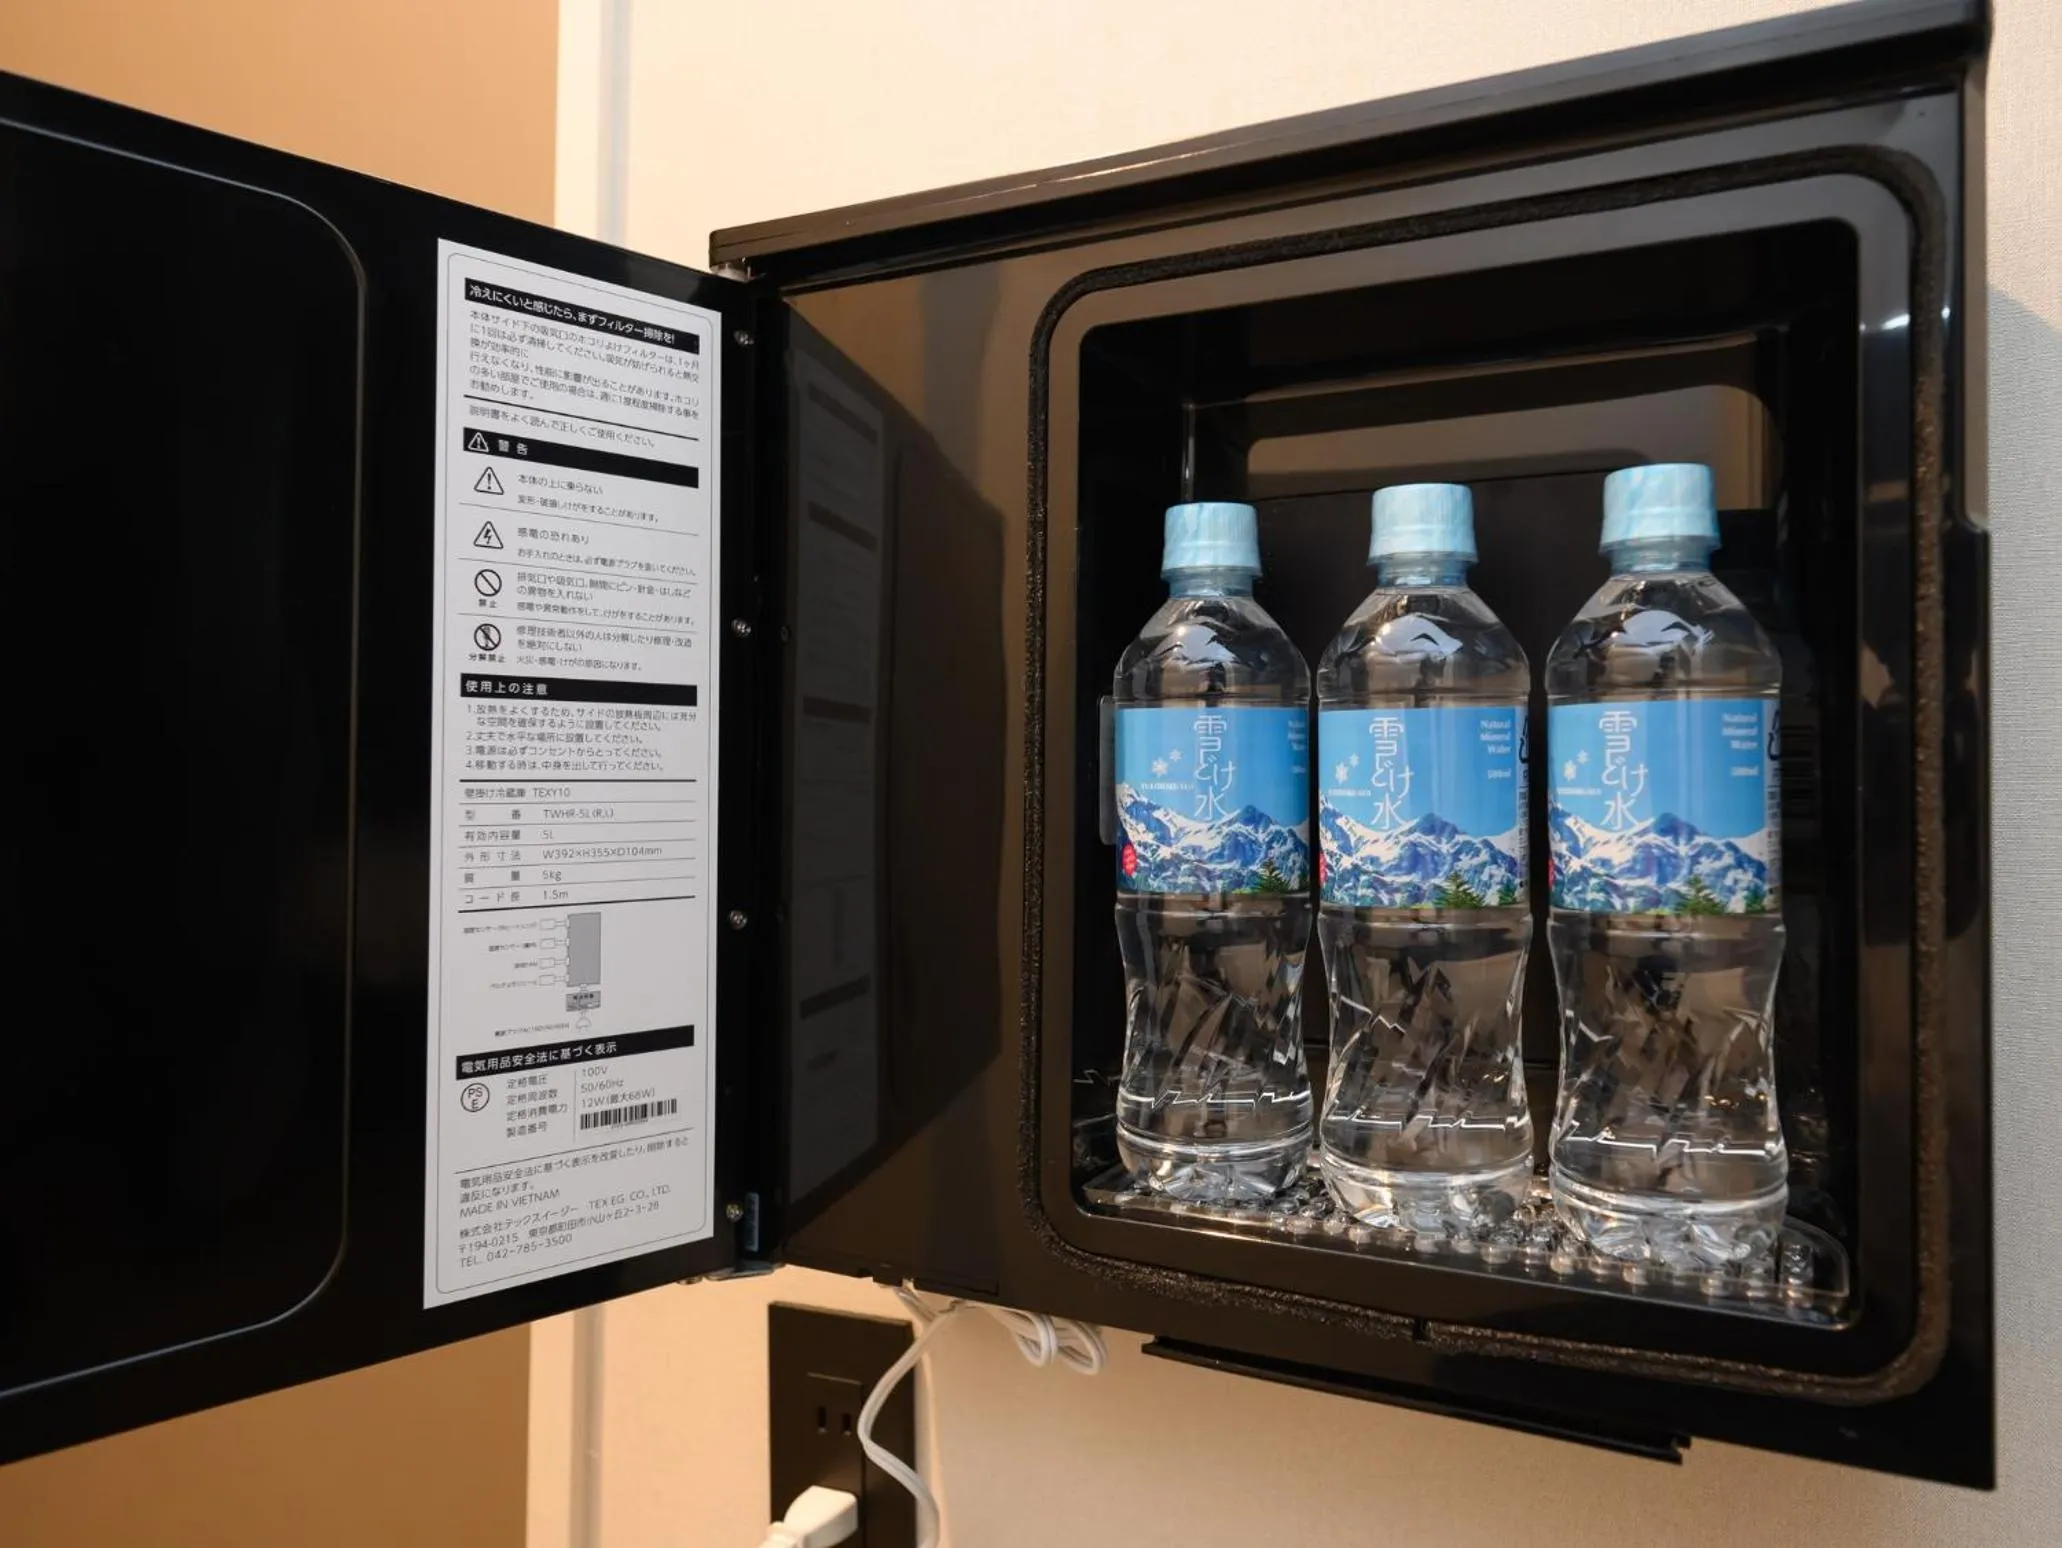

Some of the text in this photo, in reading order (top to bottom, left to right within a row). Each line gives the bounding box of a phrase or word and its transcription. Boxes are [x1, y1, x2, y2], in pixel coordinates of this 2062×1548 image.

[465, 679, 547, 696] 使用上の注意
[1194, 715, 1240, 821] 雪どけ水
[1369, 716, 1419, 830] 雪どけ水
[1599, 711, 1652, 830] 雪どけ水
[532, 787, 570, 798] TEXY10
[464, 829, 520, 841] 有効内容量
[542, 869, 561, 881] 5kg
[542, 888, 568, 900] 1.5m
[461, 1041, 616, 1074] 電気用品安全法に基づく表示
[580, 1077, 623, 1093] 50/60Hz
[459, 1187, 560, 1218] MADE IN VIETNAM
